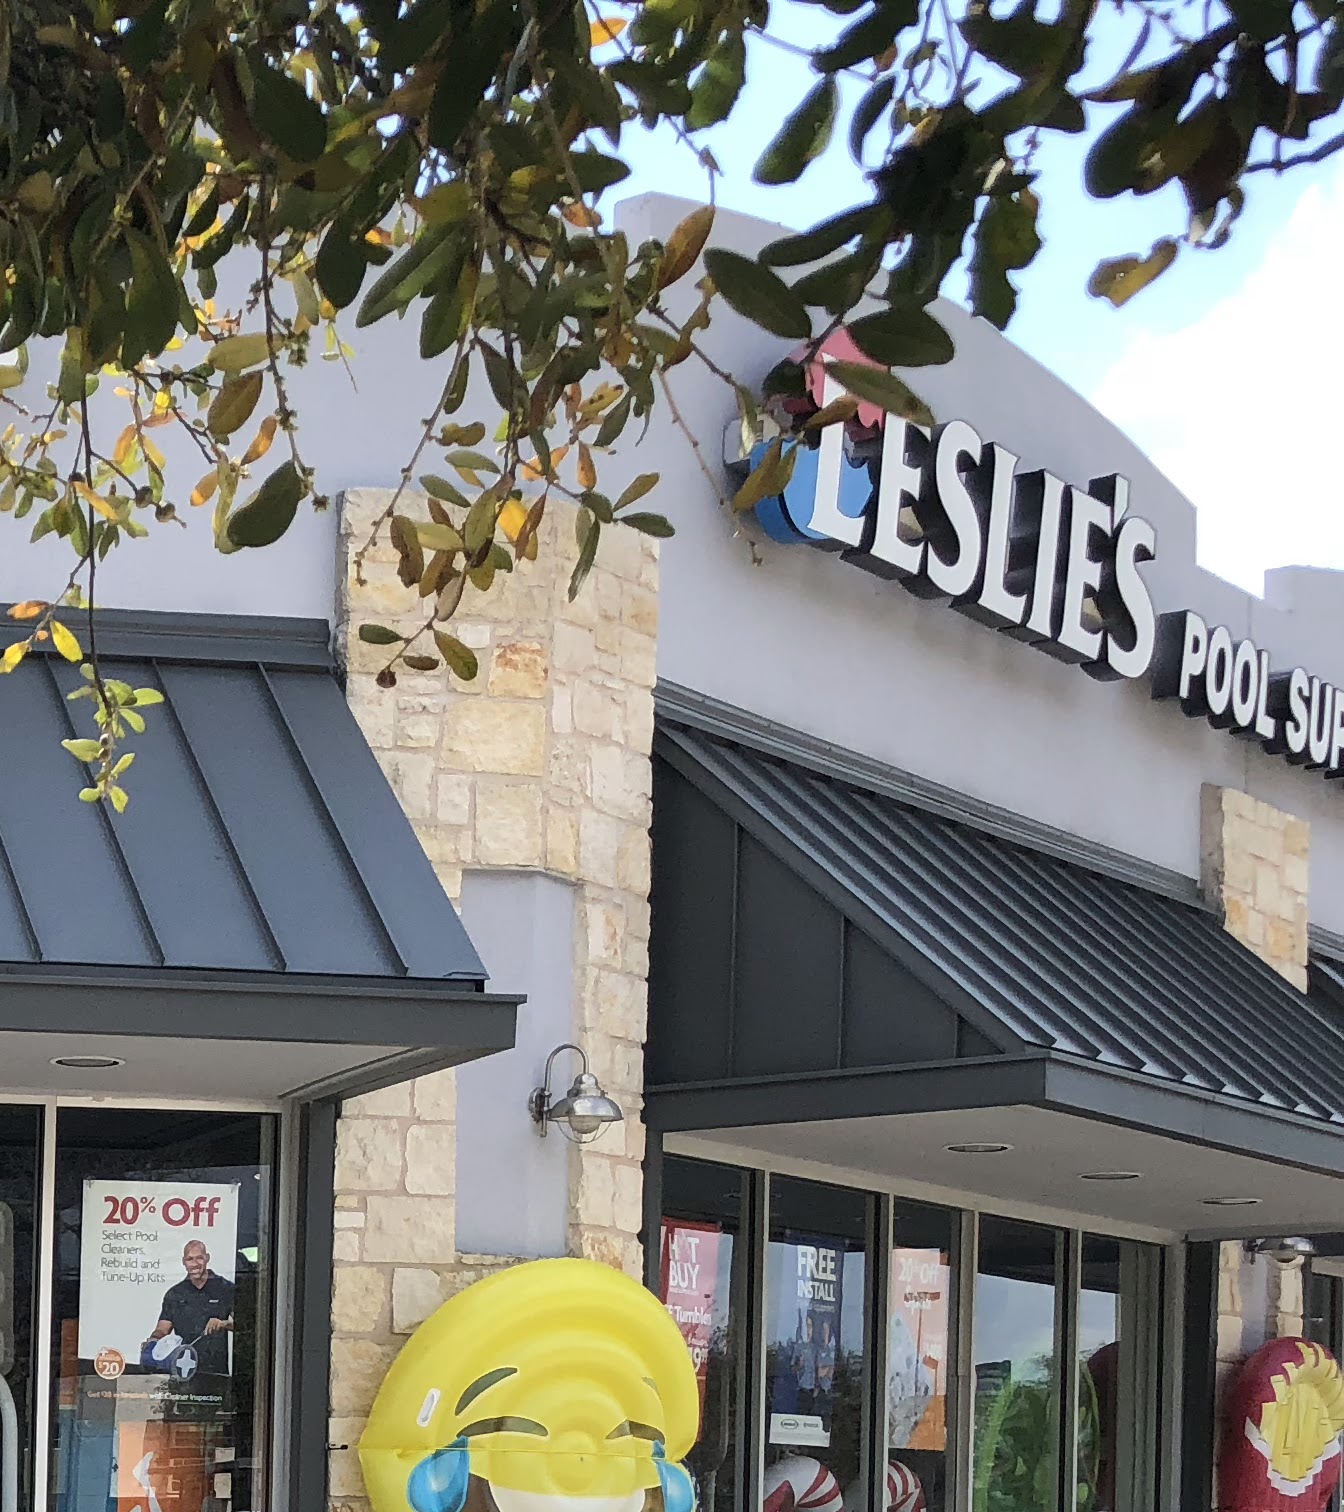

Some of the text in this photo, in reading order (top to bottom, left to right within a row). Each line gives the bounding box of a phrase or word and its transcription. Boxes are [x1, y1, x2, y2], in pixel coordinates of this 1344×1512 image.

[808, 408, 1156, 680] LESLIE'S
[1179, 611, 1276, 739] POOL
[102, 1195, 221, 1227] 20% Off
[101, 1229, 158, 1242] Select Pool
[100, 1257, 160, 1269] Rebuild and
[669, 1260, 700, 1289] BUY
[797, 1245, 836, 1281] FREE
[100, 1271, 165, 1285] Tune-Up Kits
[797, 1279, 836, 1302] INSTALL
